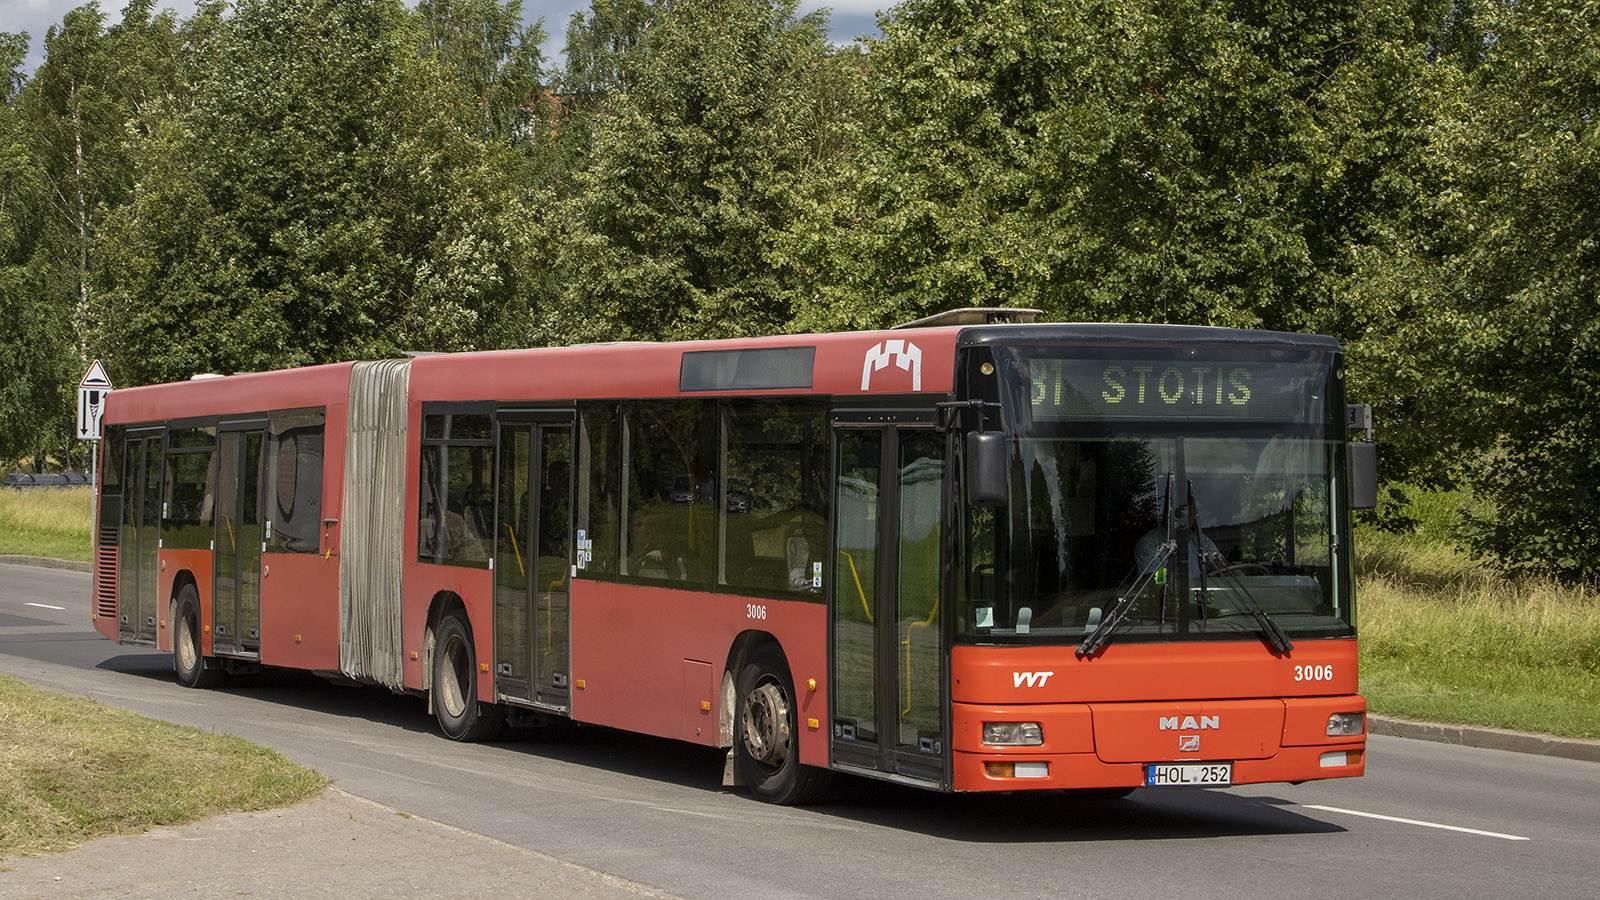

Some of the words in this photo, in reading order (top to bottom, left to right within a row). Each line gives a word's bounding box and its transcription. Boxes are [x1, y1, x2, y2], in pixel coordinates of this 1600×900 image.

[1102, 366, 1252, 405] STOTIS
[746, 603, 767, 620] 3006
[1294, 664, 1333, 682] 3006
[1159, 715, 1220, 731] MAN
[1157, 767, 1190, 783] HOL
[1200, 766, 1228, 783] 252
